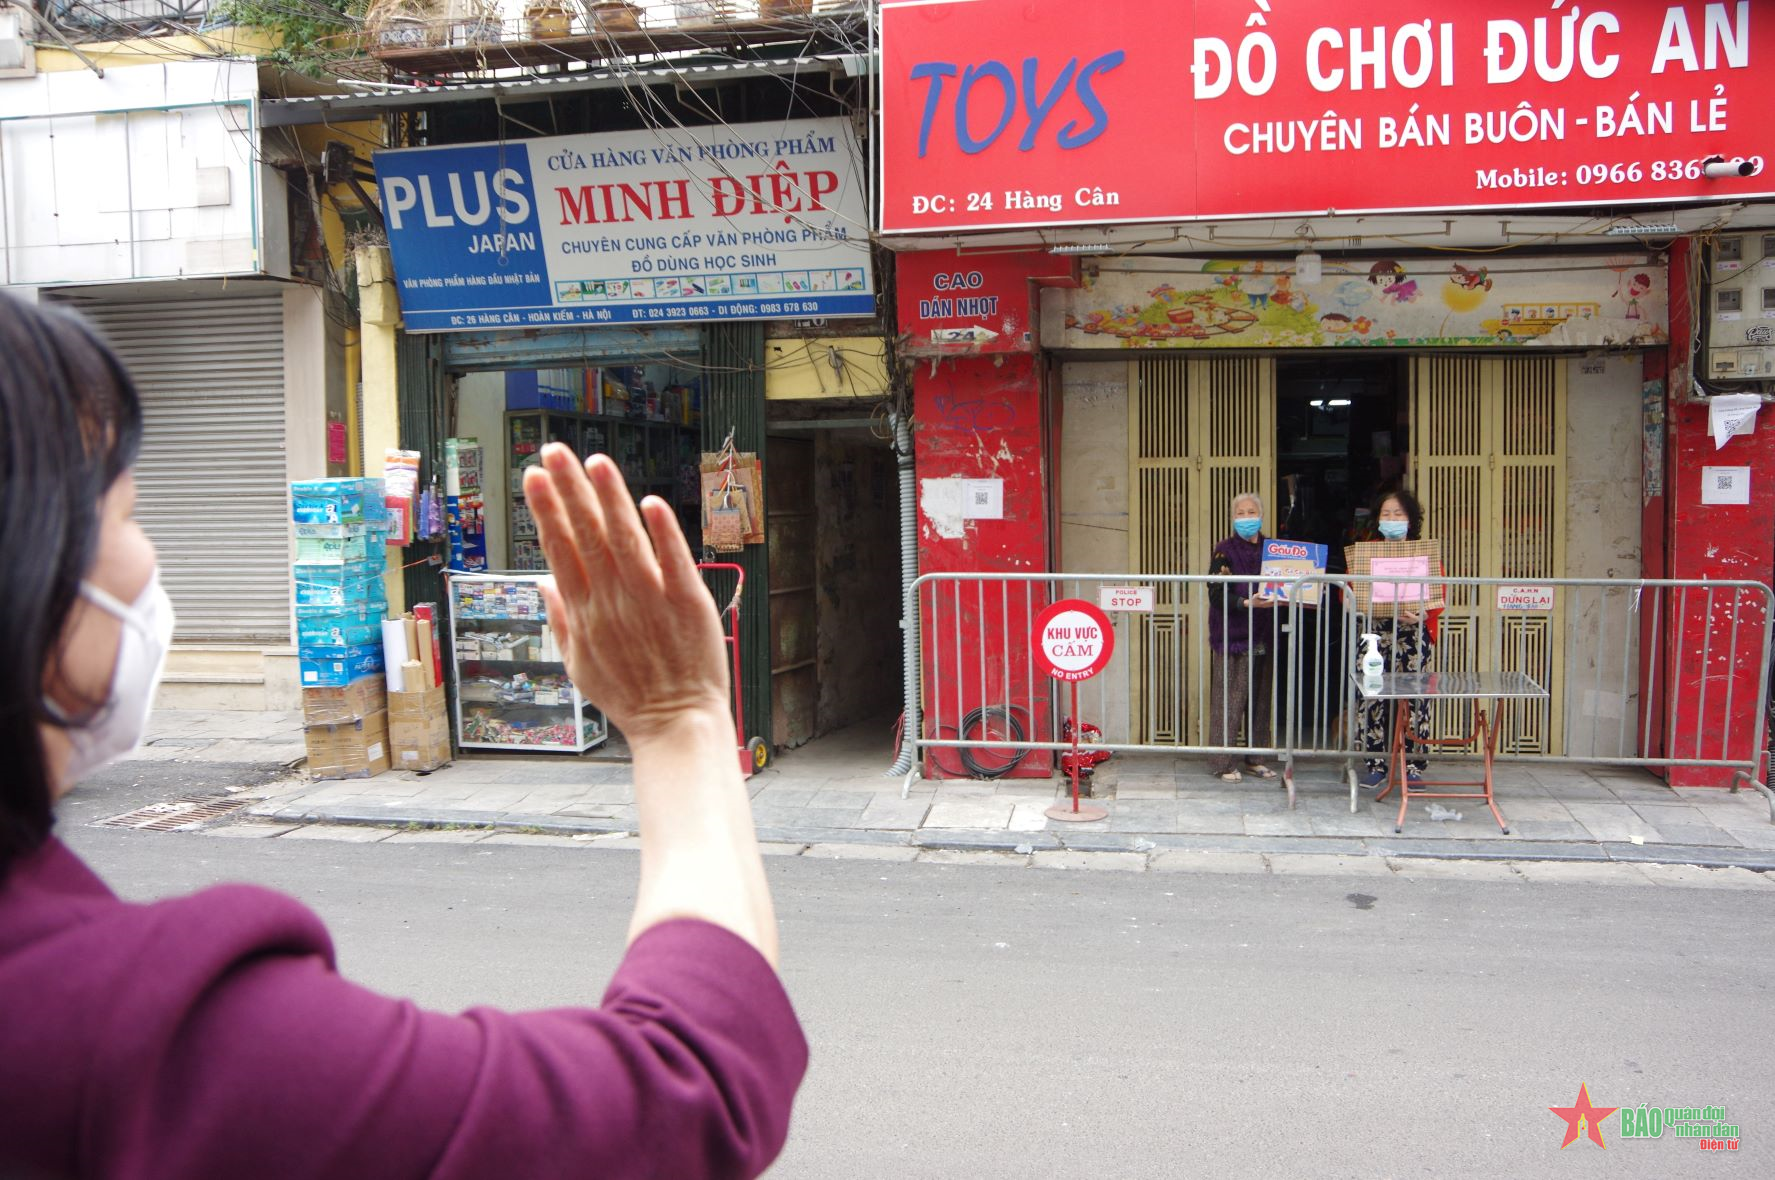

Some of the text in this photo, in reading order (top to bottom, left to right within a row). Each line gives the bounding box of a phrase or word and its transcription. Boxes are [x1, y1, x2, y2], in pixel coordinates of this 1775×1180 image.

[1190, 0, 1749, 100] ĐỒ CHƠI ĐỨC AN
[910, 48, 1126, 159] TOYS
[1223, 109, 1362, 155] CHUYÊN
[1378, 102, 1450, 149] BÁN
[1464, 100, 1565, 145] BUÔN
[1596, 90, 1673, 139] BÁN
[1690, 83, 1727, 134] LẺ
[547, 130, 836, 171] CỬA HÀNG VĂN PHÒNG PHẨM
[1475, 167, 1568, 190] Mobile:
[1575, 161, 1643, 185] 0966
[382, 168, 530, 230] PLUS
[554, 160, 839, 226] MINH ĐIỆP
[912, 186, 1120, 214] ĐC: 24 Hàng Cân
[468, 232, 536, 254] JAPAN
[561, 236, 621, 254] CHUYÊN
[625, 236, 667, 251] CUNG
[671, 229, 702, 249] CẤP
[706, 230, 738, 247] VĂN
[742, 227, 797, 245] PHÒNG
[631, 253, 777, 273] ĐỒ DÙNG HỌC SINH
[420, 276, 443, 288] PHÒNG
[445, 273, 466, 287] PHẨM
[466, 274, 487, 286] HÀNG
[933, 270, 984, 292] CAO
[466, 314, 477, 324] 26
[478, 312, 501, 324] HÀNG
[502, 312, 520, 323] CÂN
[528, 310, 550, 322] HOÀN
[553, 308, 574, 321] KIẾM
[582, 309, 594, 320] HÀ
[596, 307, 612, 321] NỘI
[648, 306, 664, 318] 024
[666, 306, 686, 317] 3923
[688, 304, 709, 316] 0663
[718, 304, 728, 315] DI
[730, 302, 758, 316] ĐỘNG:
[760, 302, 782, 314] 0983
[783, 301, 800, 312] 678
[802, 301, 818, 312] 630
[956, 296, 999, 320] NHỌT
[947, 331, 976, 341] 24
[1111, 598, 1142, 607] STOP
[1047, 625, 1098, 642] KHU VỰC
[1052, 640, 1094, 657] CẤM
[1051, 667, 1094, 680] NO ENTRY
